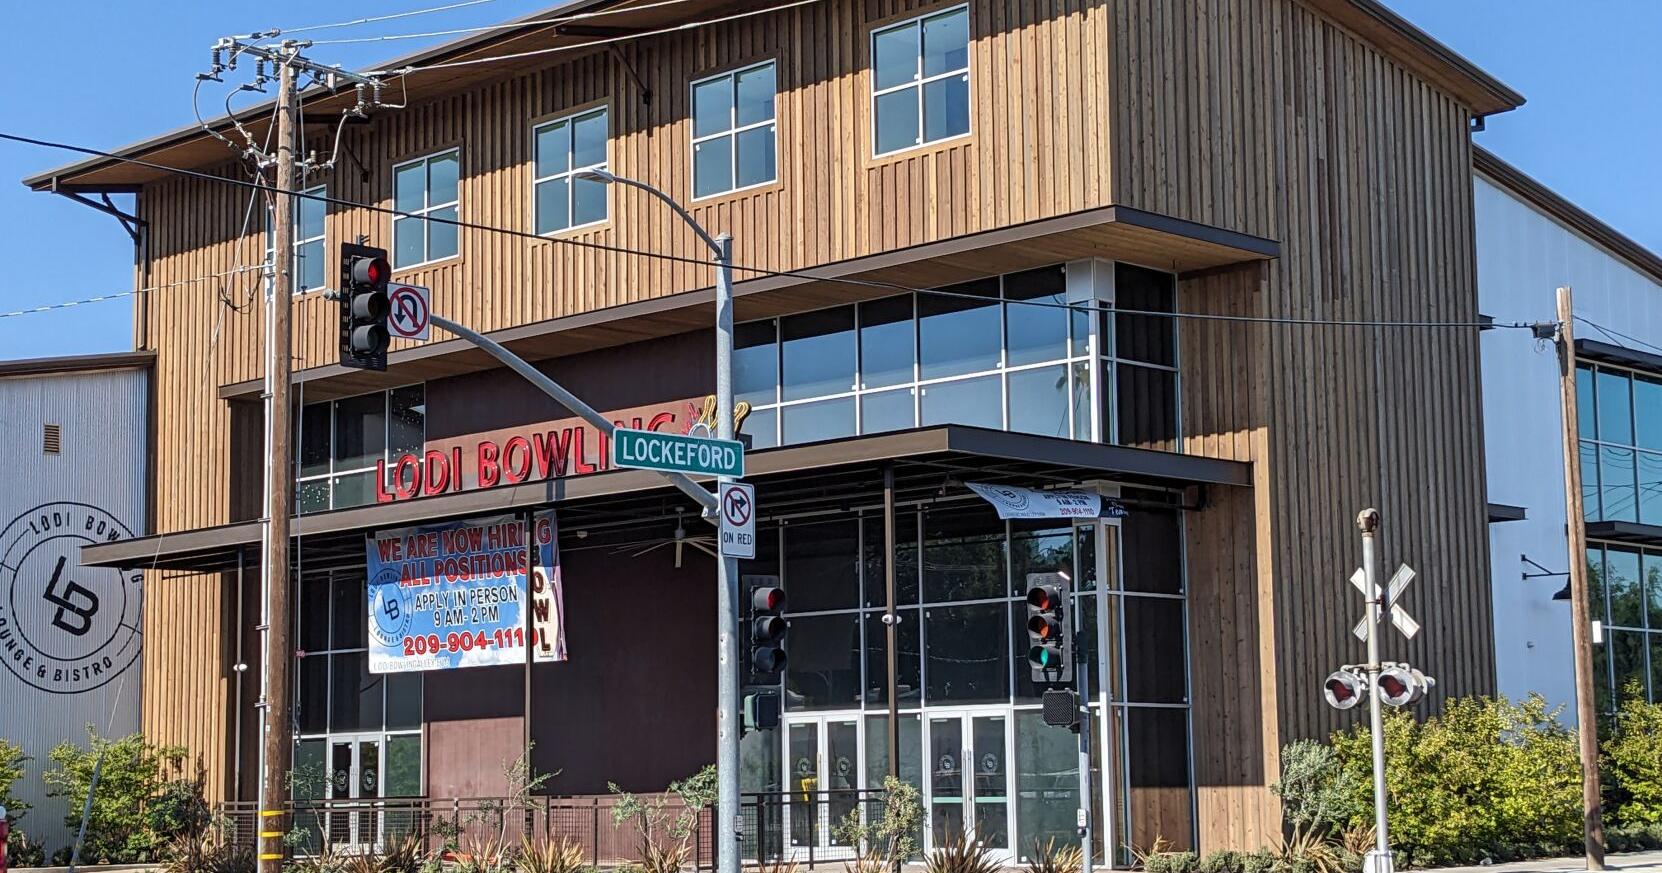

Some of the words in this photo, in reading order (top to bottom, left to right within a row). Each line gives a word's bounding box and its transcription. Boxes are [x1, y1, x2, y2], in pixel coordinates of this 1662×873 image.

[622, 436, 736, 470] LOCKEFORD
[376, 446, 464, 503] LODI
[29, 512, 70, 535] LODI
[723, 531, 735, 544] ON
[737, 533, 752, 545] RED
[377, 537, 402, 563] WE
[406, 531, 438, 559] ARE
[443, 526, 484, 555] NOW
[400, 561, 431, 588] ALL
[434, 549, 527, 585] POSITIONS
[415, 592, 449, 611] APPLY
[453, 591, 466, 607] IN
[470, 585, 518, 605] PERSON
[434, 611, 442, 627] 9
[471, 609, 479, 624] 2
[481, 605, 499, 622] PM
[0, 606, 33, 671] OUNGE
[37, 664, 47, 678] &
[54, 656, 112, 682] BISTRO
